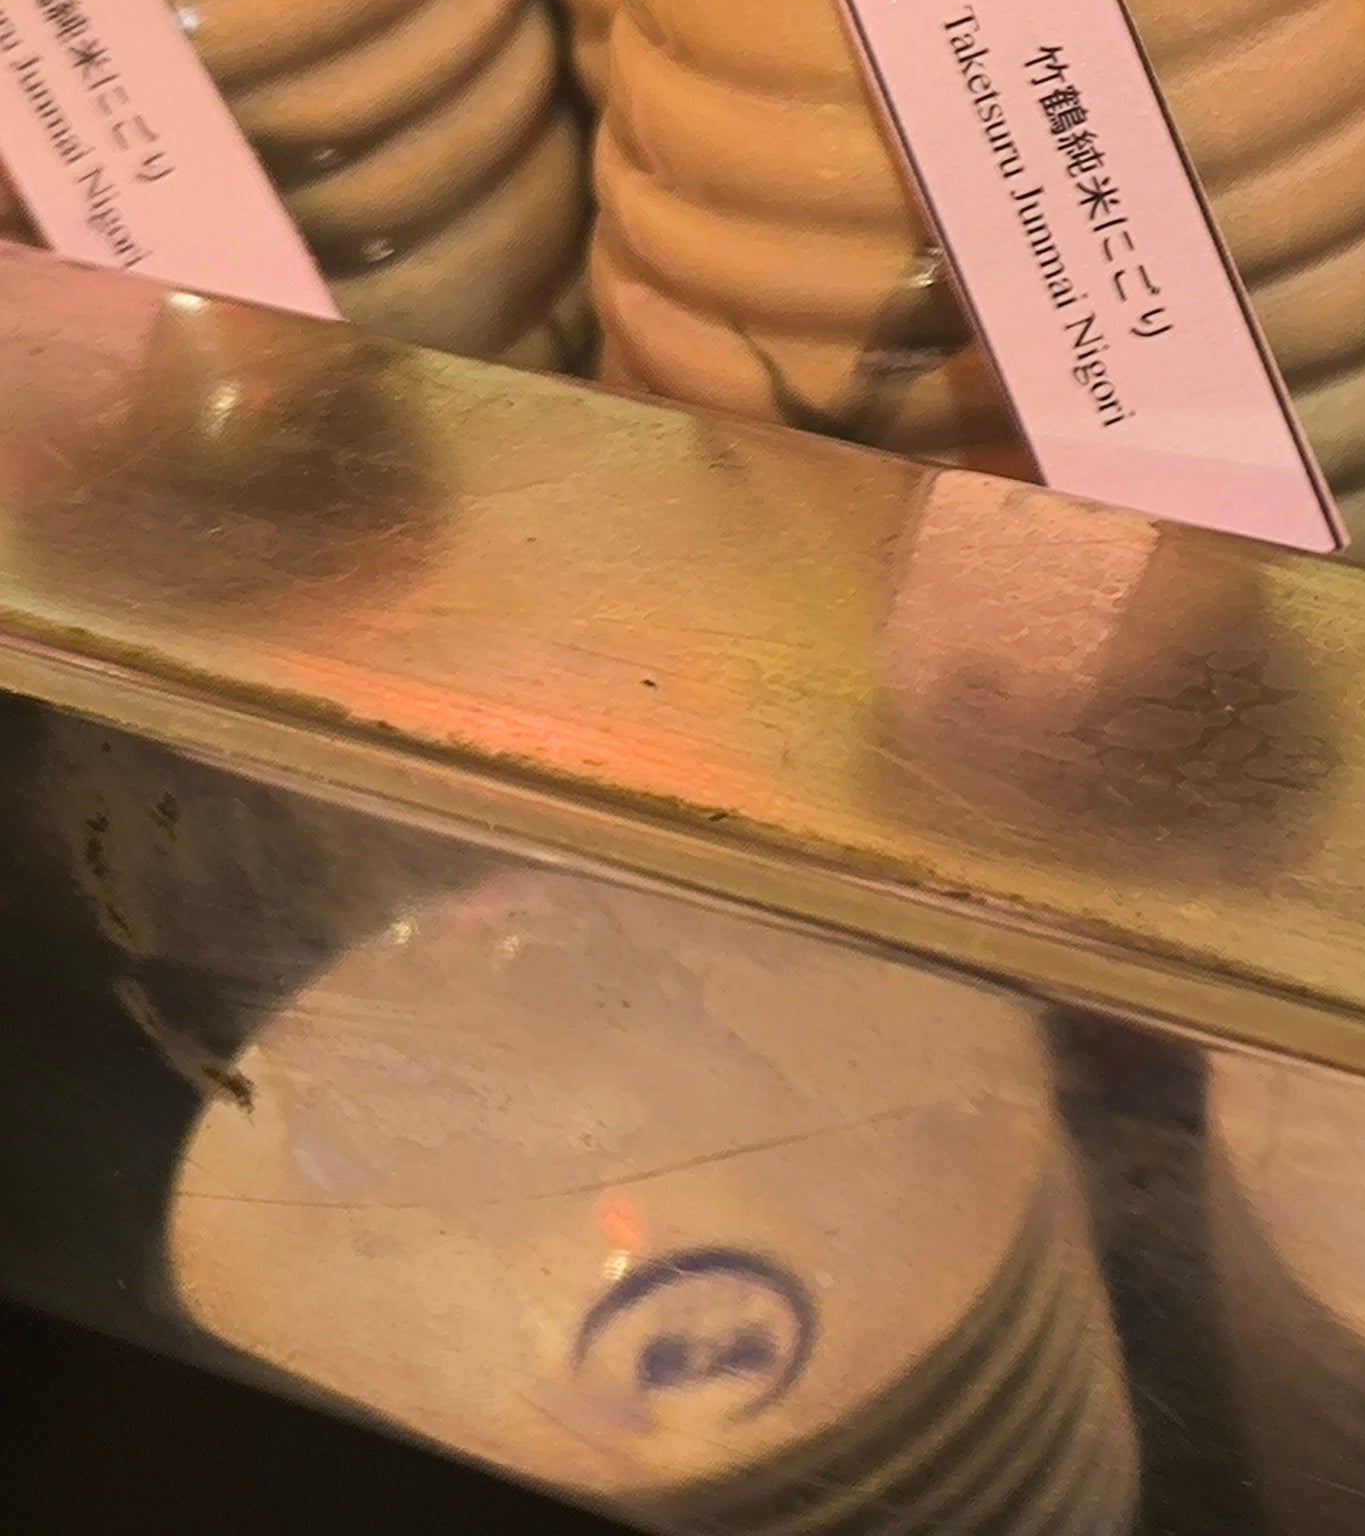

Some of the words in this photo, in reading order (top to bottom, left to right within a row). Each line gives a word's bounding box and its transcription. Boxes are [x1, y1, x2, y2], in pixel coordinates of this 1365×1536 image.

[944, 5, 1026, 179] Taketsuru
[1011, 185, 1089, 310] Junmai
[1065, 312, 1137, 429] Nigori
[1025, 45, 1173, 338] 竹鶴純米にごり
